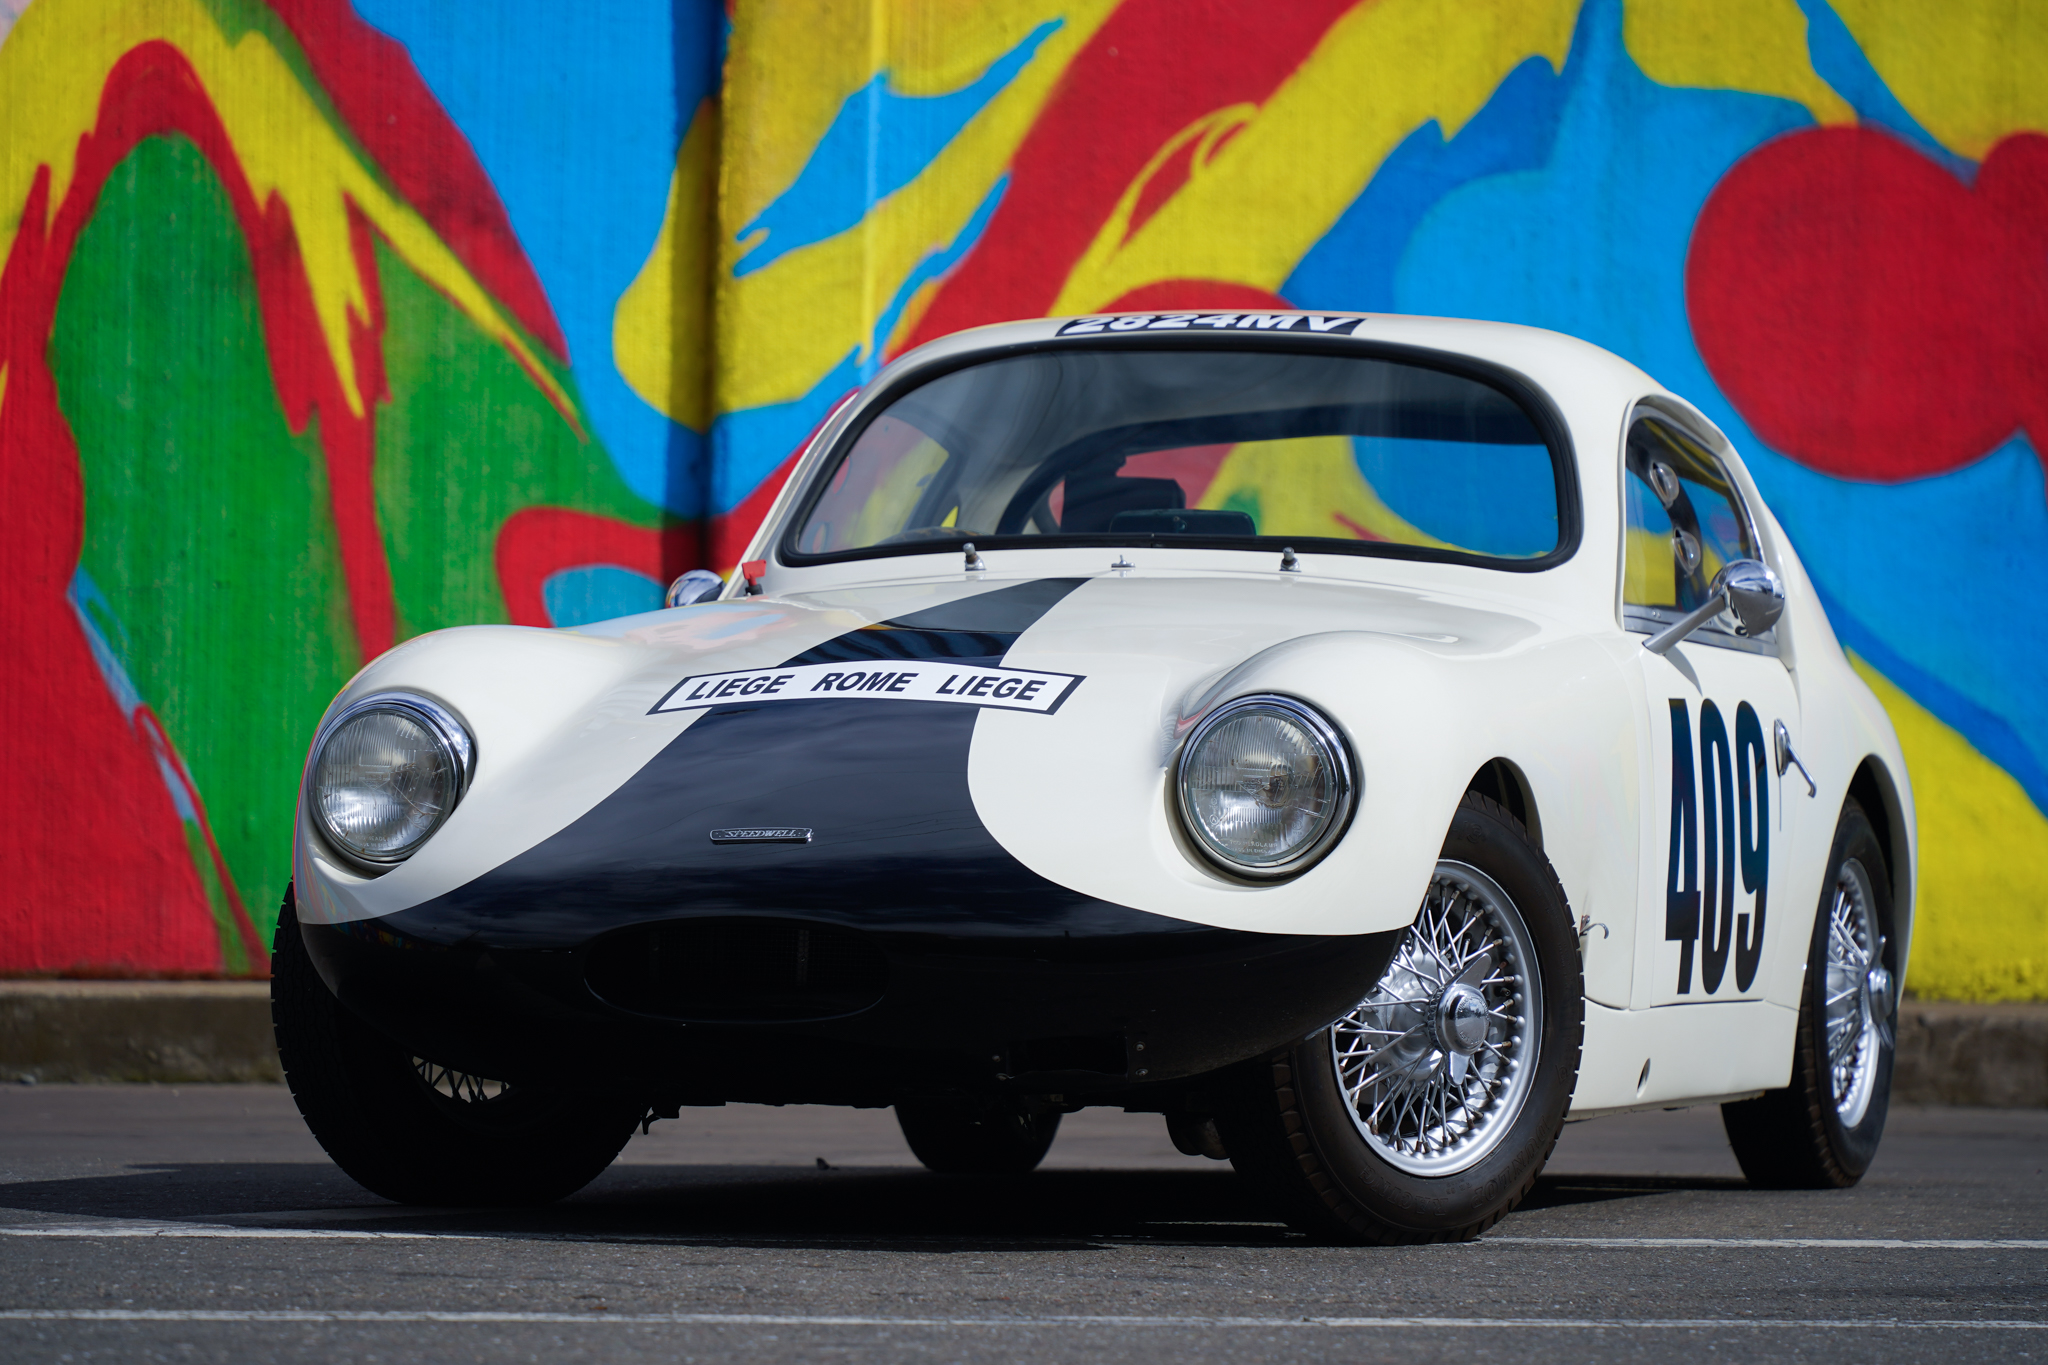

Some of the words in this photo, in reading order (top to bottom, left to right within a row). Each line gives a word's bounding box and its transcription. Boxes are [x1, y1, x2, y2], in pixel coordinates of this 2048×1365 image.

[1062, 313, 1359, 335] 2824MV
[685, 674, 796, 701] LIEGE
[810, 672, 919, 692] ROME
[936, 674, 1048, 701] LIEGE
[724, 829, 797, 838] SPEEDWELL
[1665, 698, 1770, 995] 409
[1470, 1115, 1551, 1210] DUNLOP
[1357, 1164, 1449, 1217] RACING
